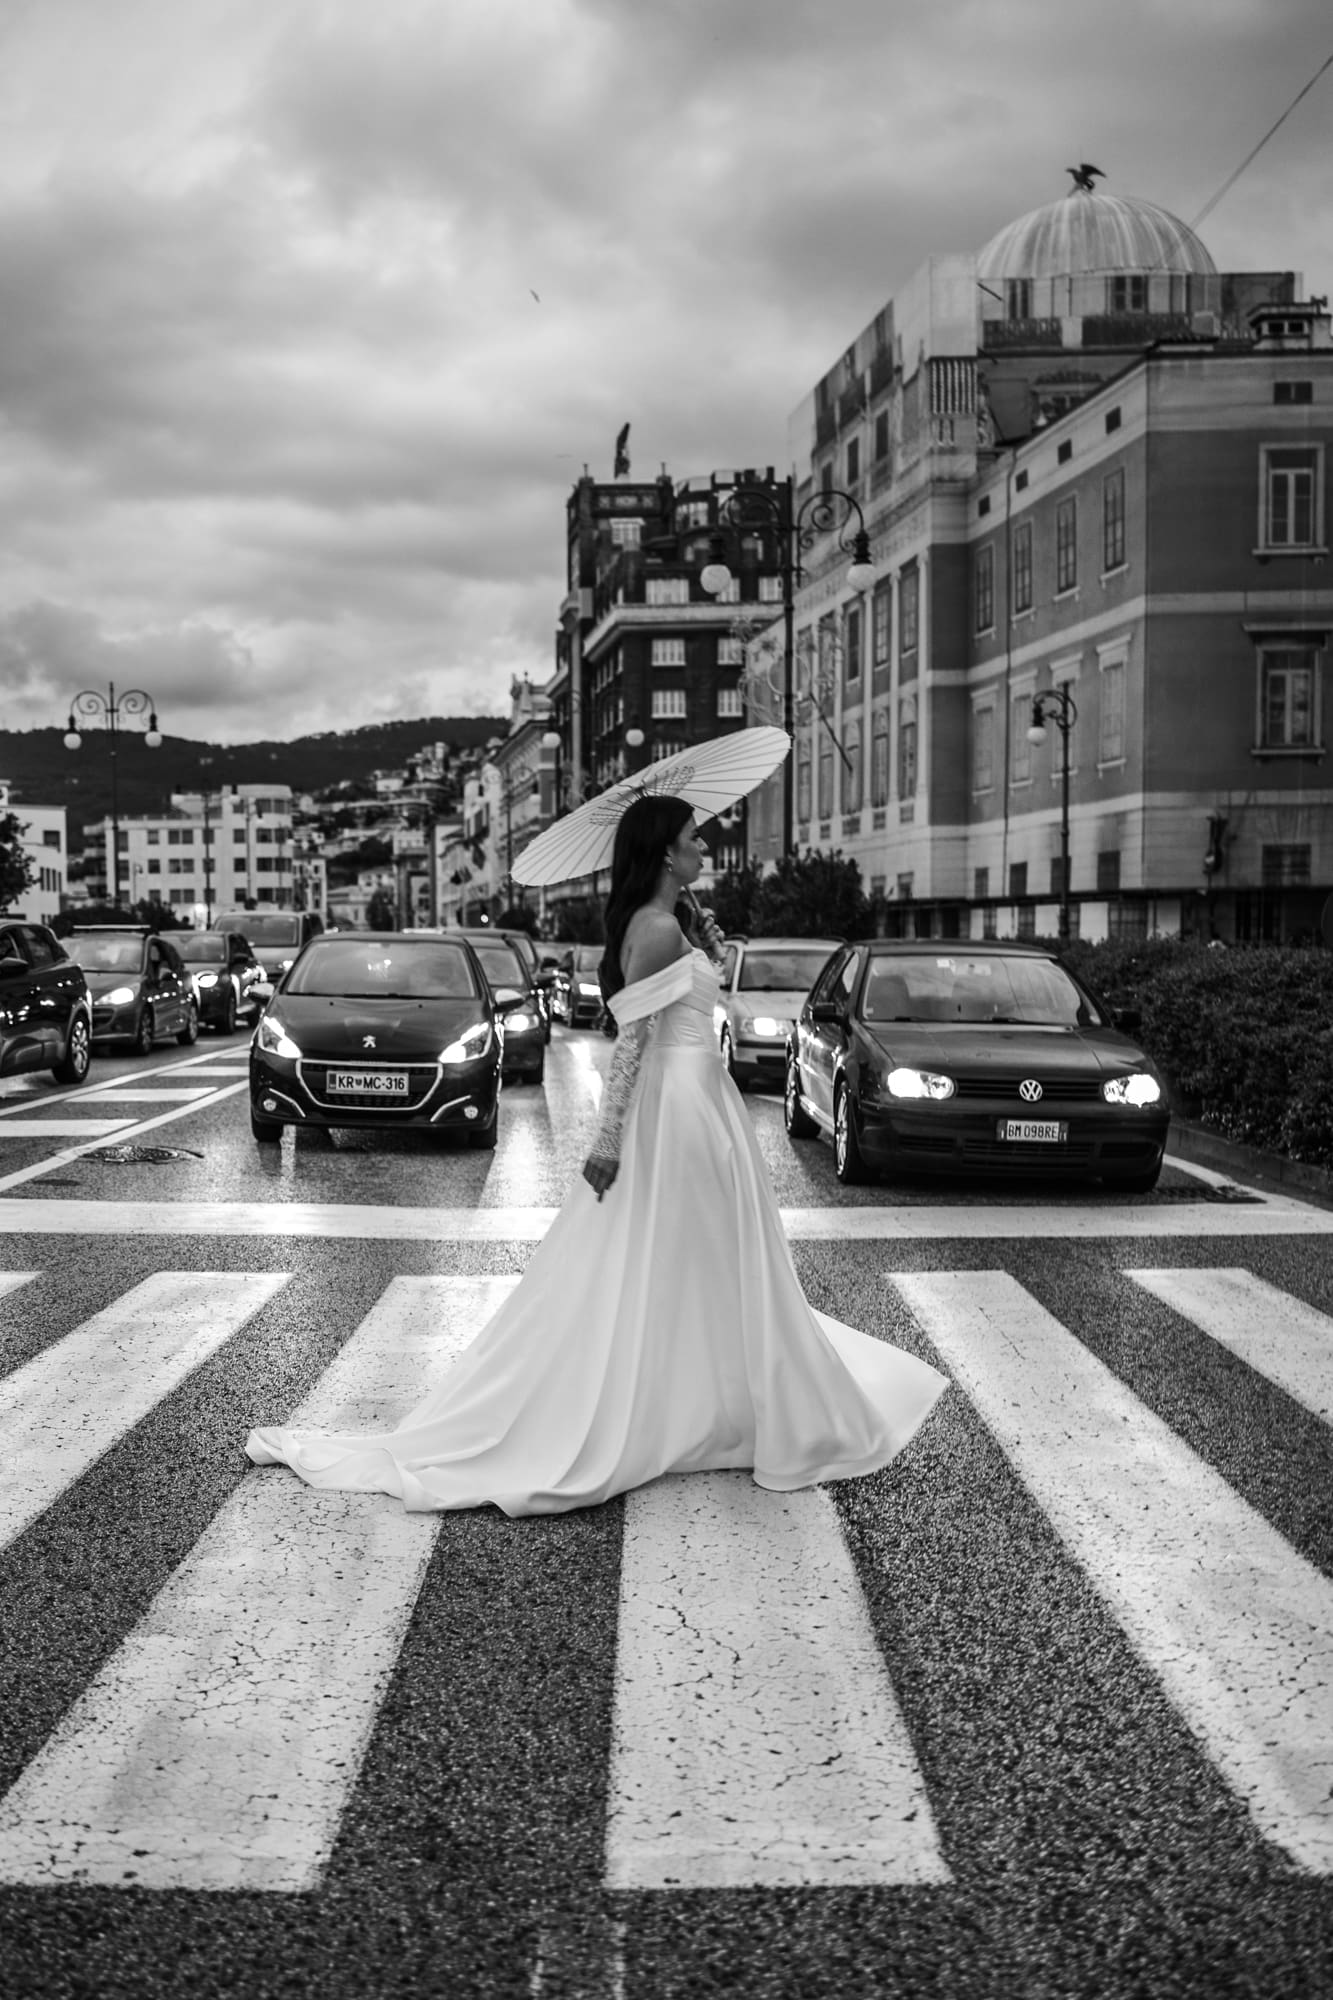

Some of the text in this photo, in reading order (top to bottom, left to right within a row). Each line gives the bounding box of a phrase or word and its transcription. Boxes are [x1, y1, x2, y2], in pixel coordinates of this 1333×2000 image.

[338, 1076, 405, 1090] KR MC-316
[1019, 1079, 1043, 1102] VW
